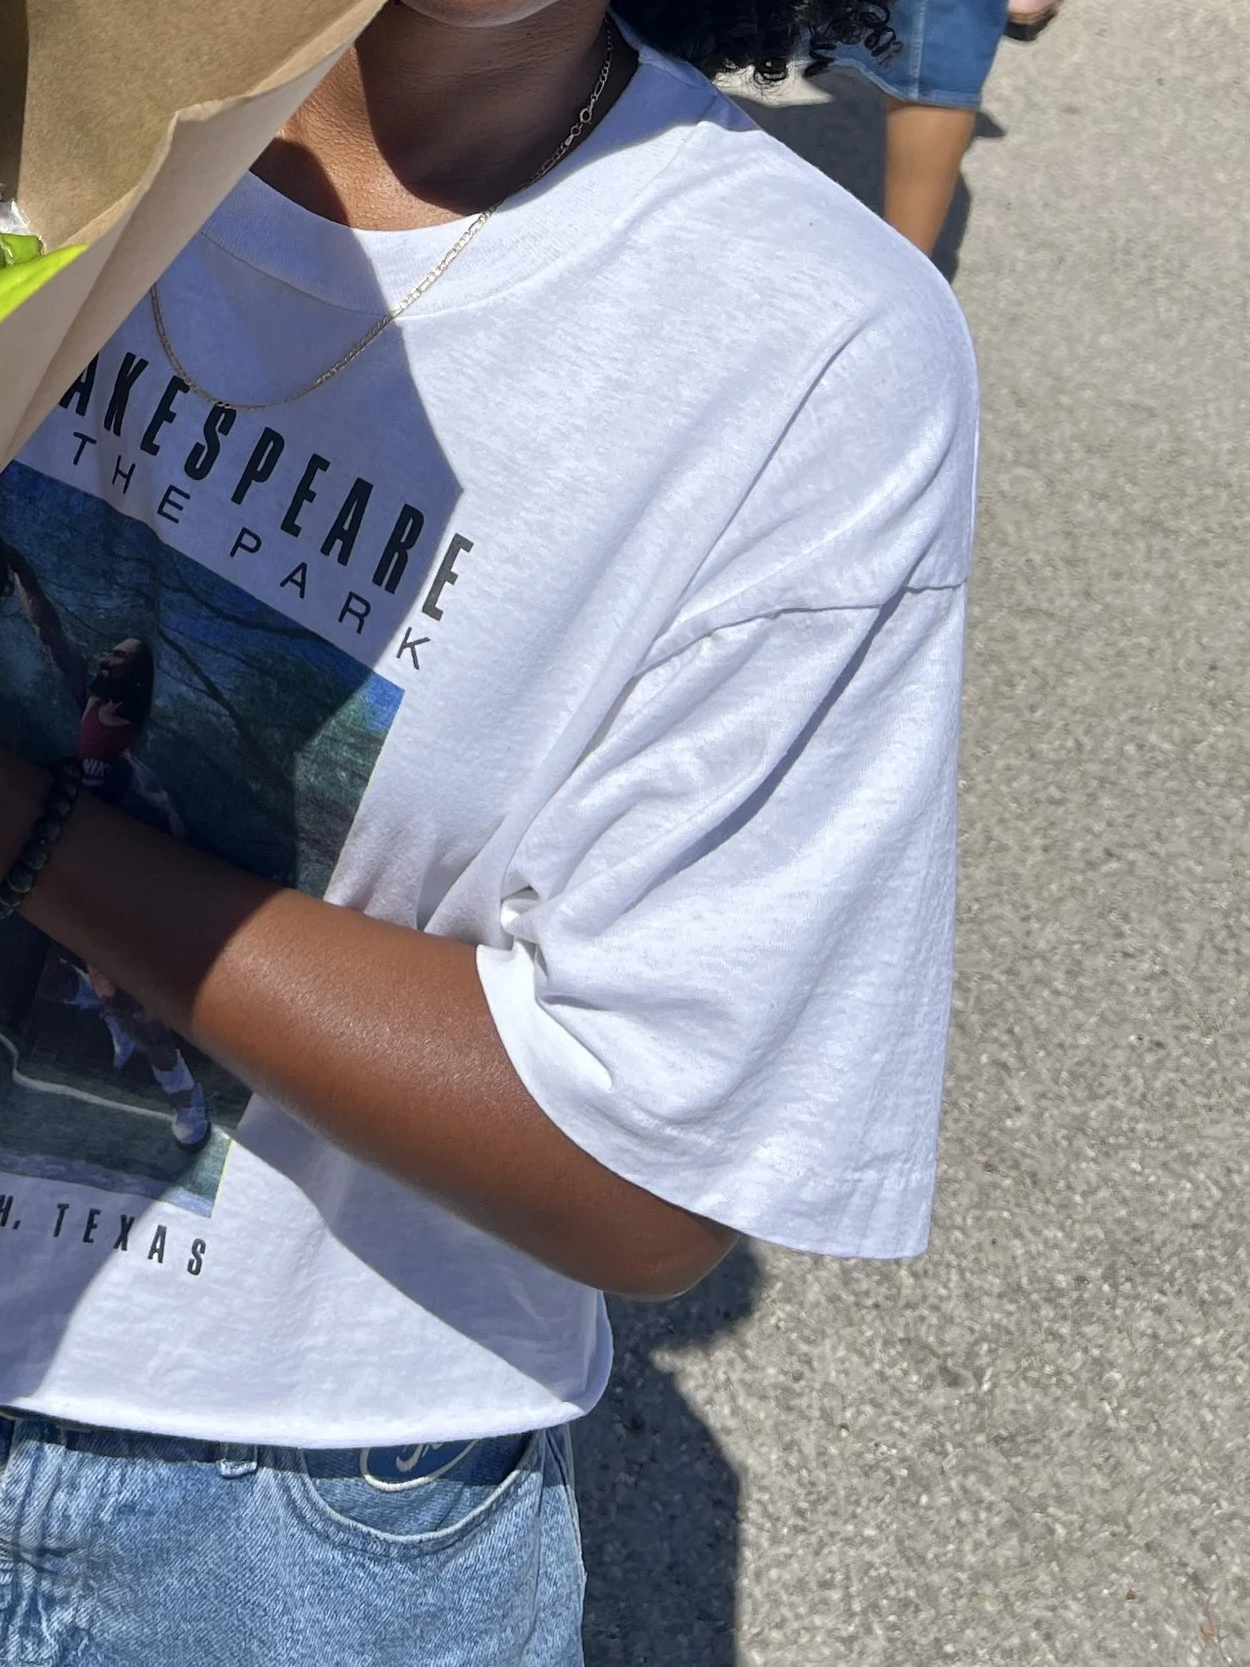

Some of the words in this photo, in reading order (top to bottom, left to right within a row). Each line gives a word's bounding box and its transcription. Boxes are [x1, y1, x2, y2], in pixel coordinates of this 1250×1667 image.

[73, 431, 190, 524] THE
[230, 526, 431, 671] PARK
[53, 1203, 206, 1276] TEXAS
